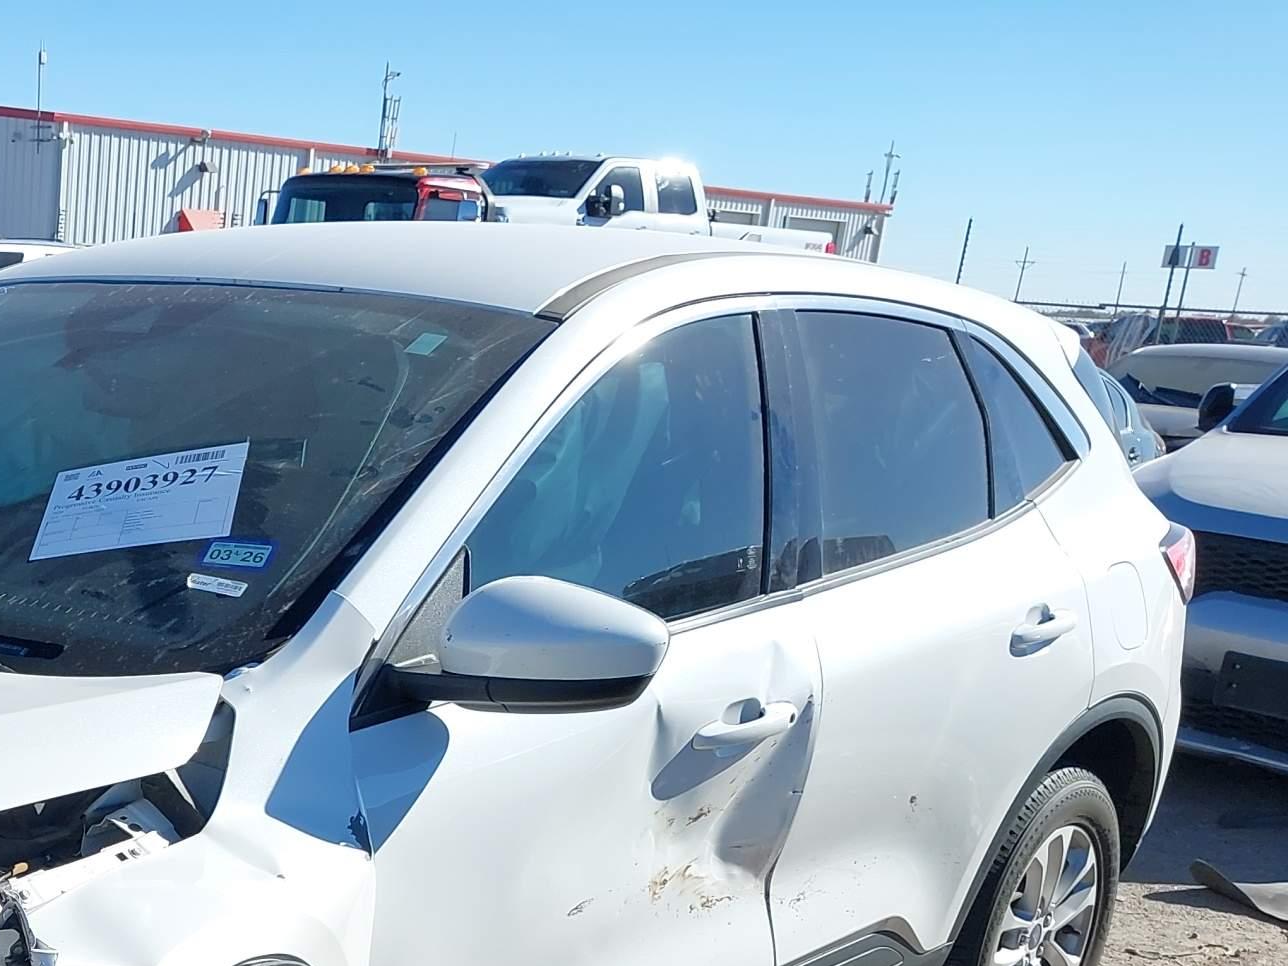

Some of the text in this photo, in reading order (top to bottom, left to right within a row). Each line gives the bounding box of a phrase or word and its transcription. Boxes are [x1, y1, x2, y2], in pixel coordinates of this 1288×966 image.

[1198, 248, 1212, 267] B
[67, 465, 219, 501] 43903927
[209, 548, 266, 564] 03 26
